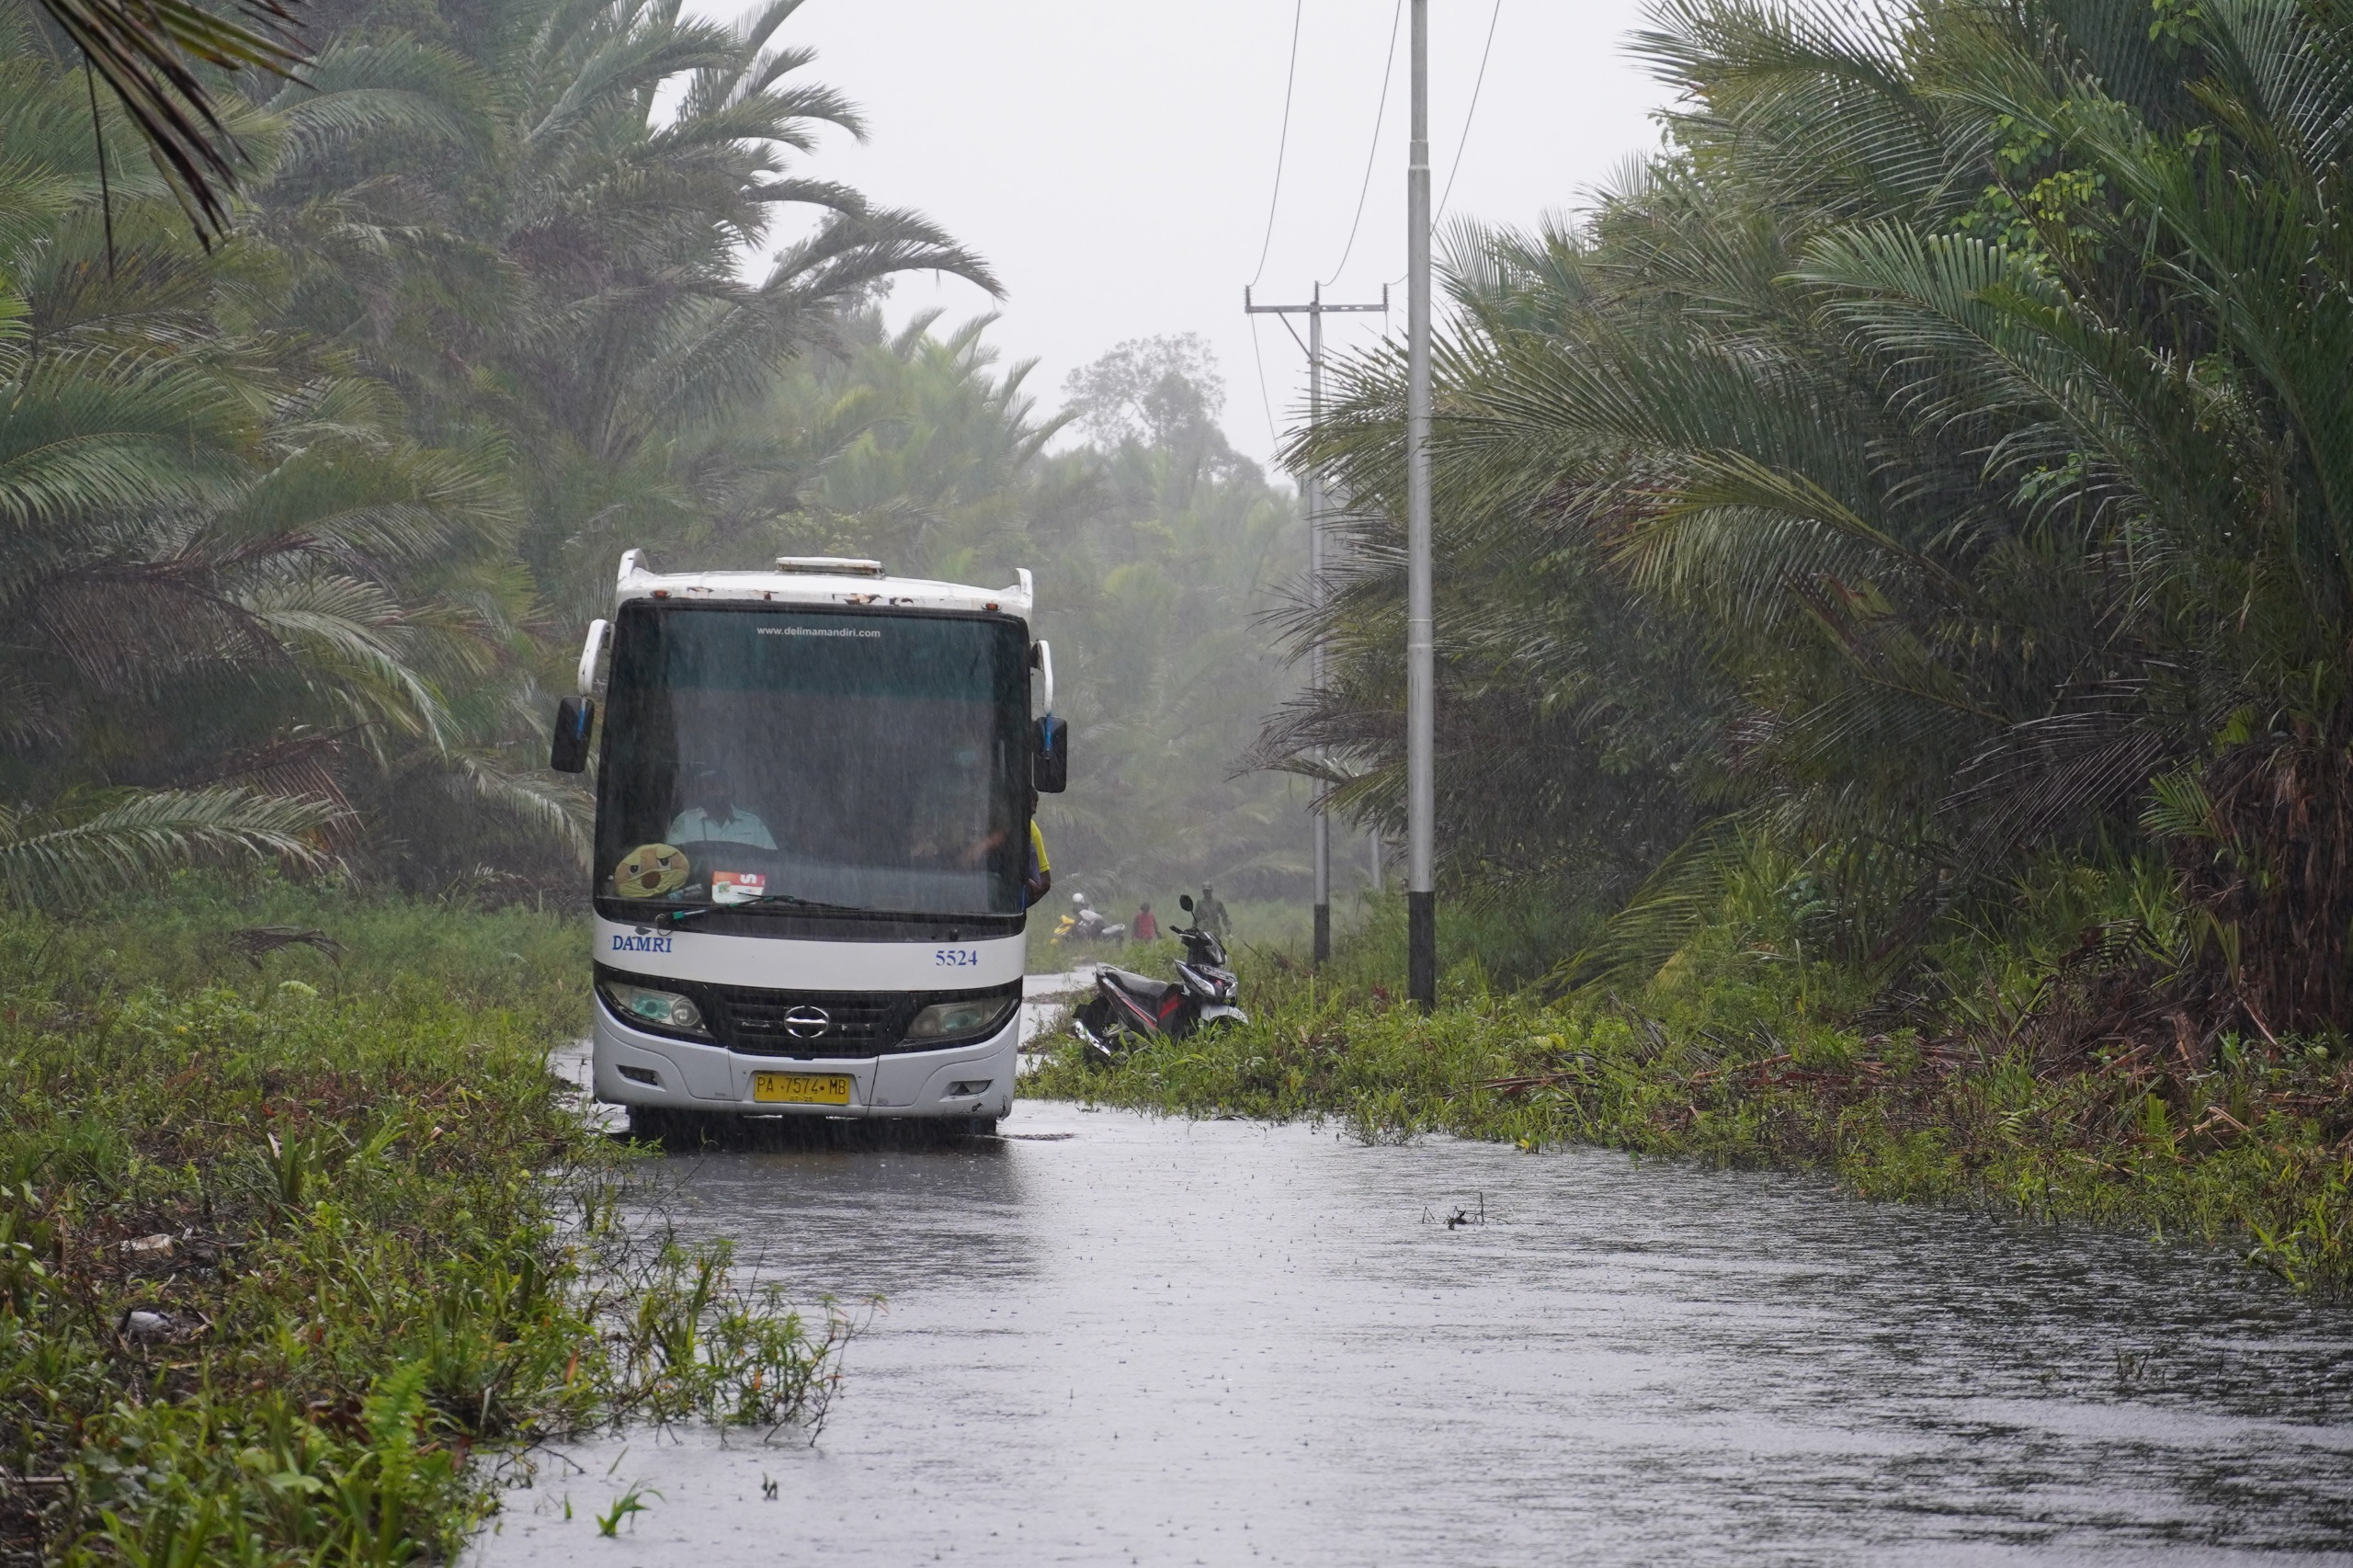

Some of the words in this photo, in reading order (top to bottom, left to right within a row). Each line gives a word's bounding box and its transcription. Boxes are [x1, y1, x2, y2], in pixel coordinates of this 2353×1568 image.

[756, 626, 881, 638] www.delimamandiri.com
[612, 935, 672, 953] DAMRI
[936, 949, 978, 966] 5524
[756, 1076, 774, 1093] PA
[785, 1077, 819, 1094] 7574
[829, 1079, 847, 1095] MB
